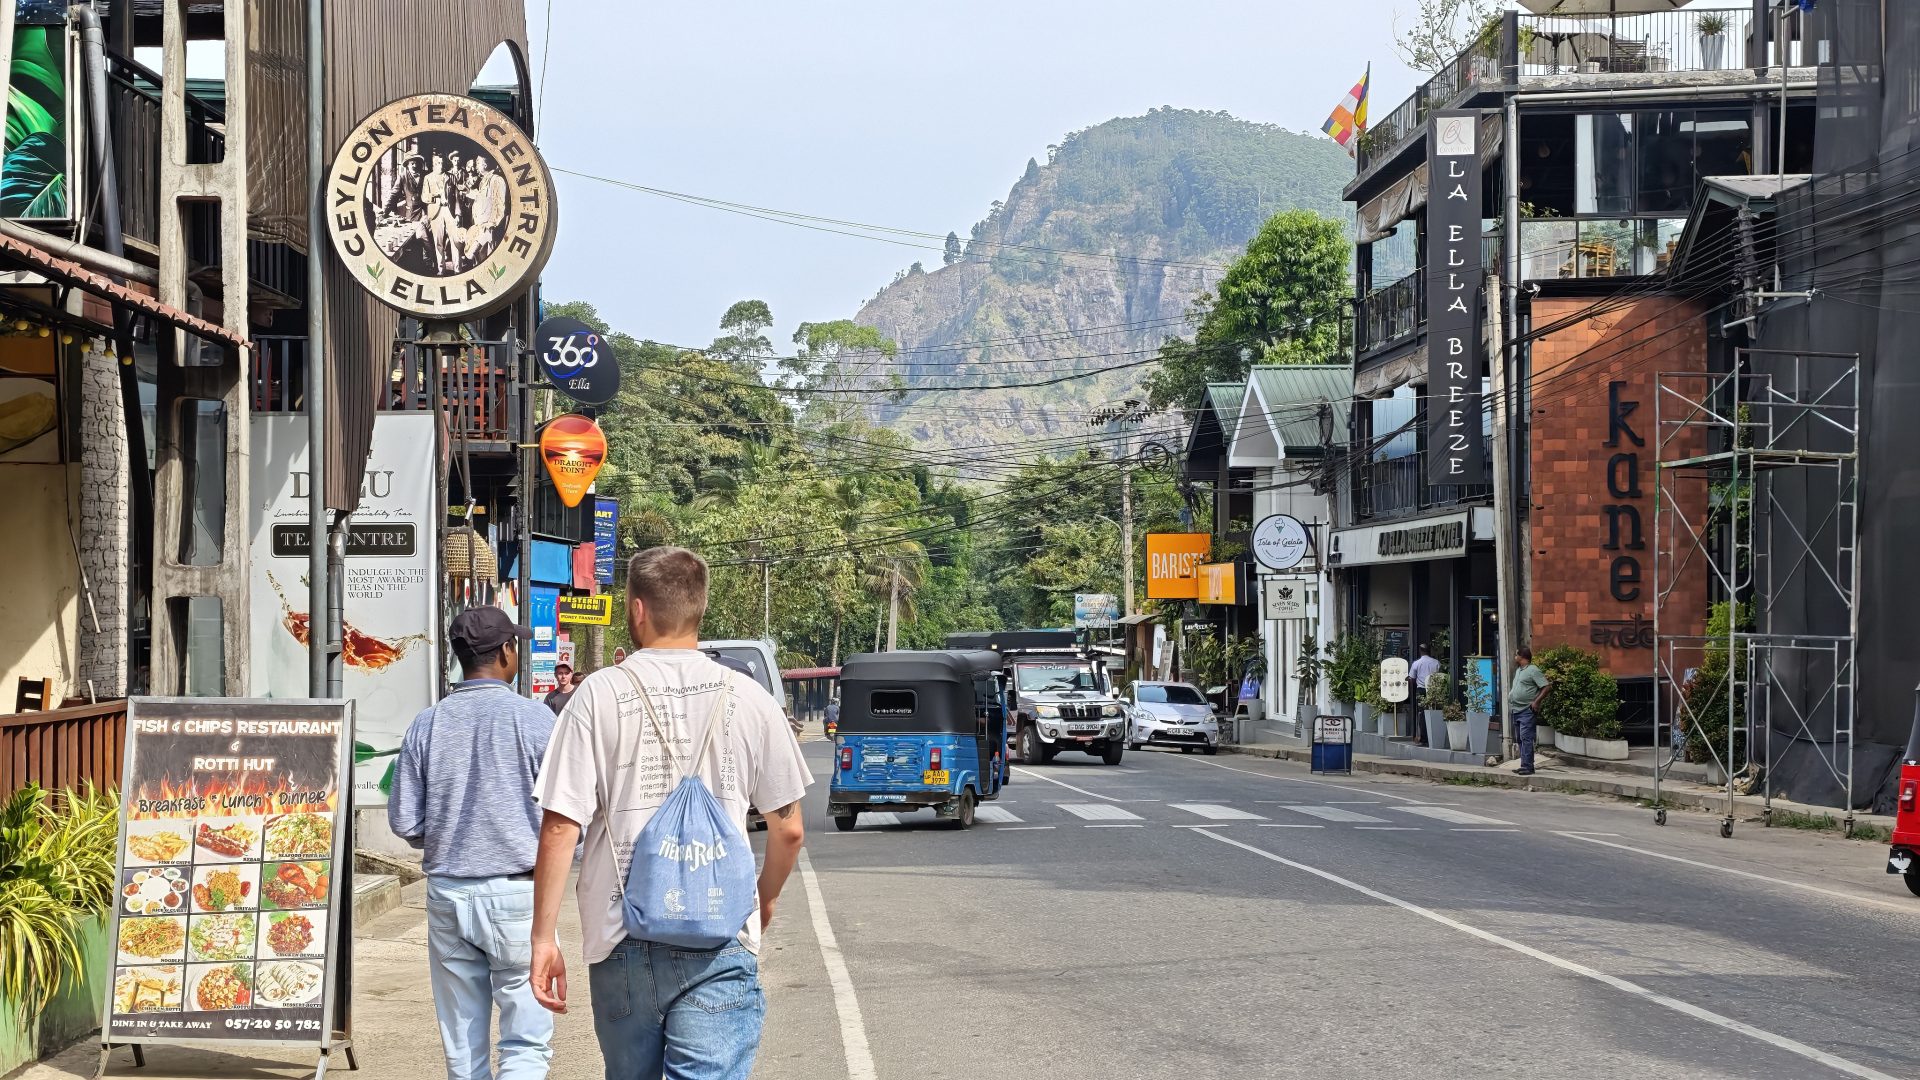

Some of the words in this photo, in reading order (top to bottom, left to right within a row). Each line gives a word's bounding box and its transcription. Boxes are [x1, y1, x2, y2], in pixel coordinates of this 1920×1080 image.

[336, 120, 394, 257] CEYLON
[402, 104, 469, 129] TEA
[484, 123, 540, 260] CENTRE
[1447, 160, 1468, 201] LA
[1447, 224, 1468, 314] ELLA
[389, 276, 488, 306] ELLA
[568, 378, 591, 390] Ella
[1447, 337, 1470, 475] BREEZE
[554, 459, 593, 468] DRAUGHT
[560, 466, 586, 474] POINT
[1602, 380, 1646, 602] kane
[348, 568, 393, 576] INDULGE
[395, 568, 405, 576] IN
[408, 568, 428, 576] THE
[347, 583, 372, 591] TEAS
[374, 583, 384, 591] IN
[386, 583, 407, 591] THE
[347, 591, 383, 599] WORLD
[559, 596, 599, 605] WESTERN
[571, 602, 599, 611] UNION
[662, 685, 699, 695] UNKNOWN
[134, 719, 168, 733] FISH
[184, 720, 233, 734] CHIPS
[237, 720, 341, 735] RESTAURANT
[193, 757, 239, 771] ROTTI
[243, 758, 274, 771] HUT
[138, 797, 206, 813] Breakfast
[222, 794, 262, 809] Lunch
[112, 1020, 136, 1028] DINE
[136, 1020, 148, 1028] IN
[149, 1020, 158, 1029] &
[159, 1021, 185, 1029] TAKE
[186, 1021, 213, 1030] AWAY
[225, 1018, 272, 1030] 057-20
[274, 1019, 292, 1030] 50
[295, 1019, 321, 1031] 782
